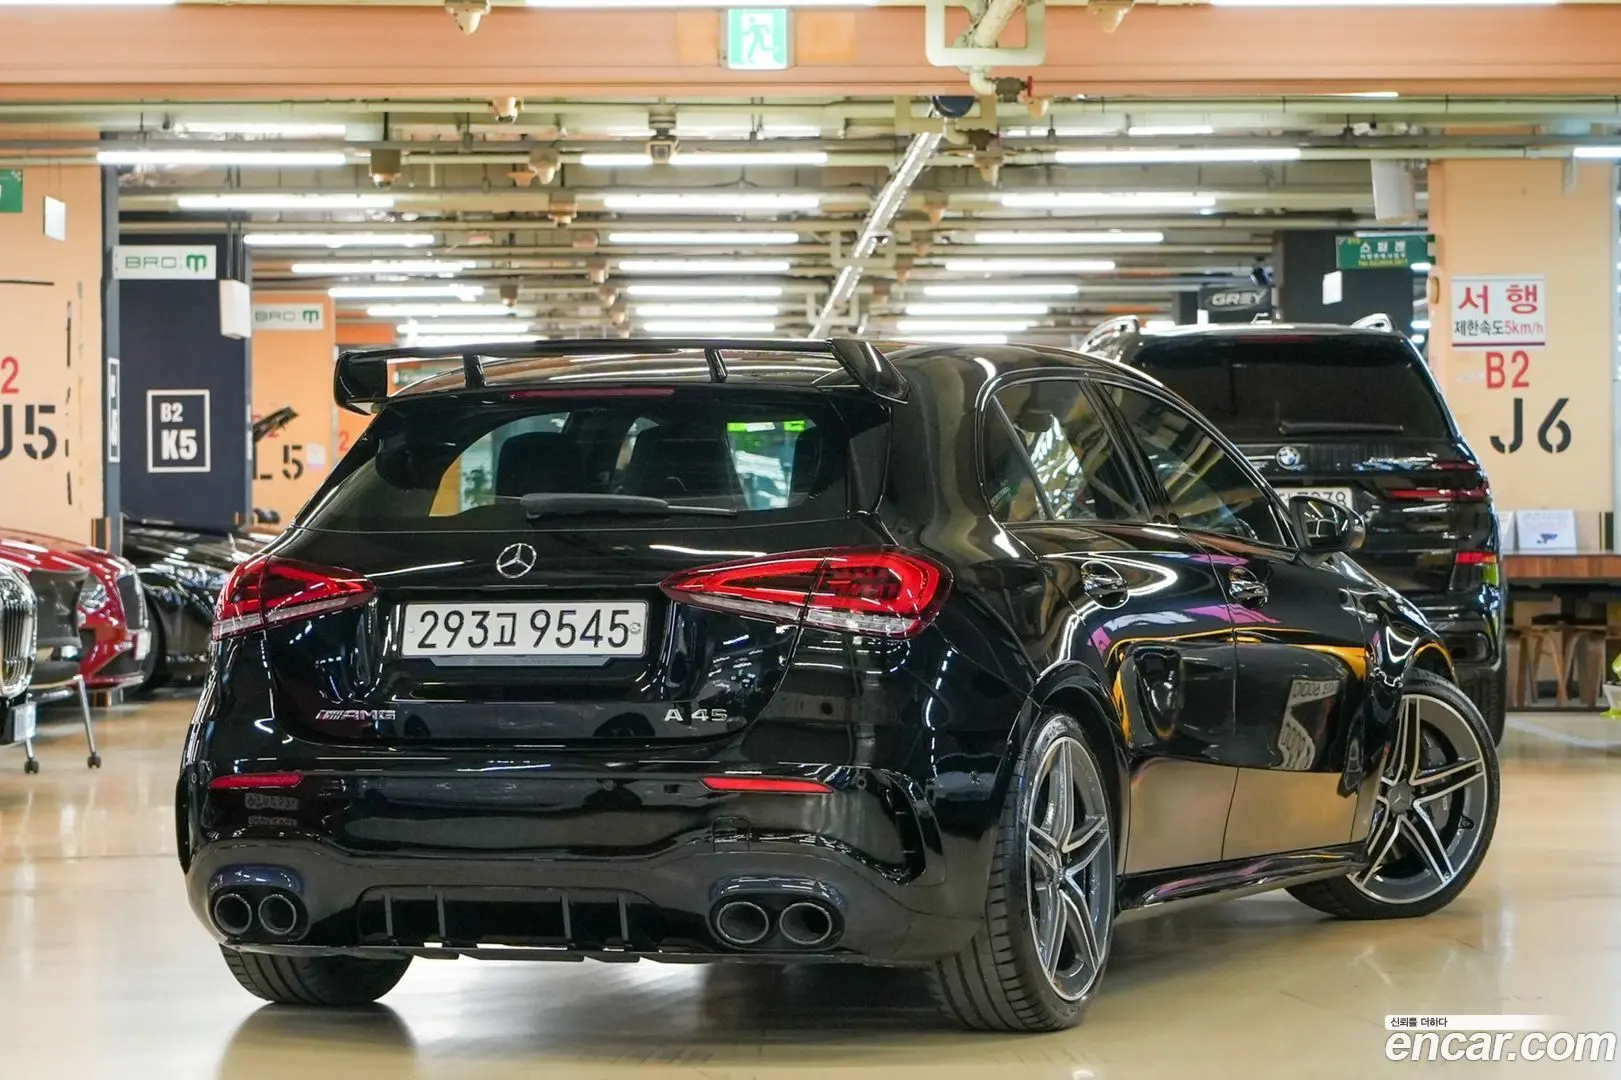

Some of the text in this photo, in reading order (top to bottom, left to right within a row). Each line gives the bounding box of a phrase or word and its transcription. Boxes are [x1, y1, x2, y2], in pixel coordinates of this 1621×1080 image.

[1485, 350, 1530, 389] B2
[159, 401, 184, 423] B2
[1489, 397, 1572, 454] J6
[160, 429, 198, 460] K5
[529, 608, 630, 649] 9545
[341, 709, 396, 720] AMG
